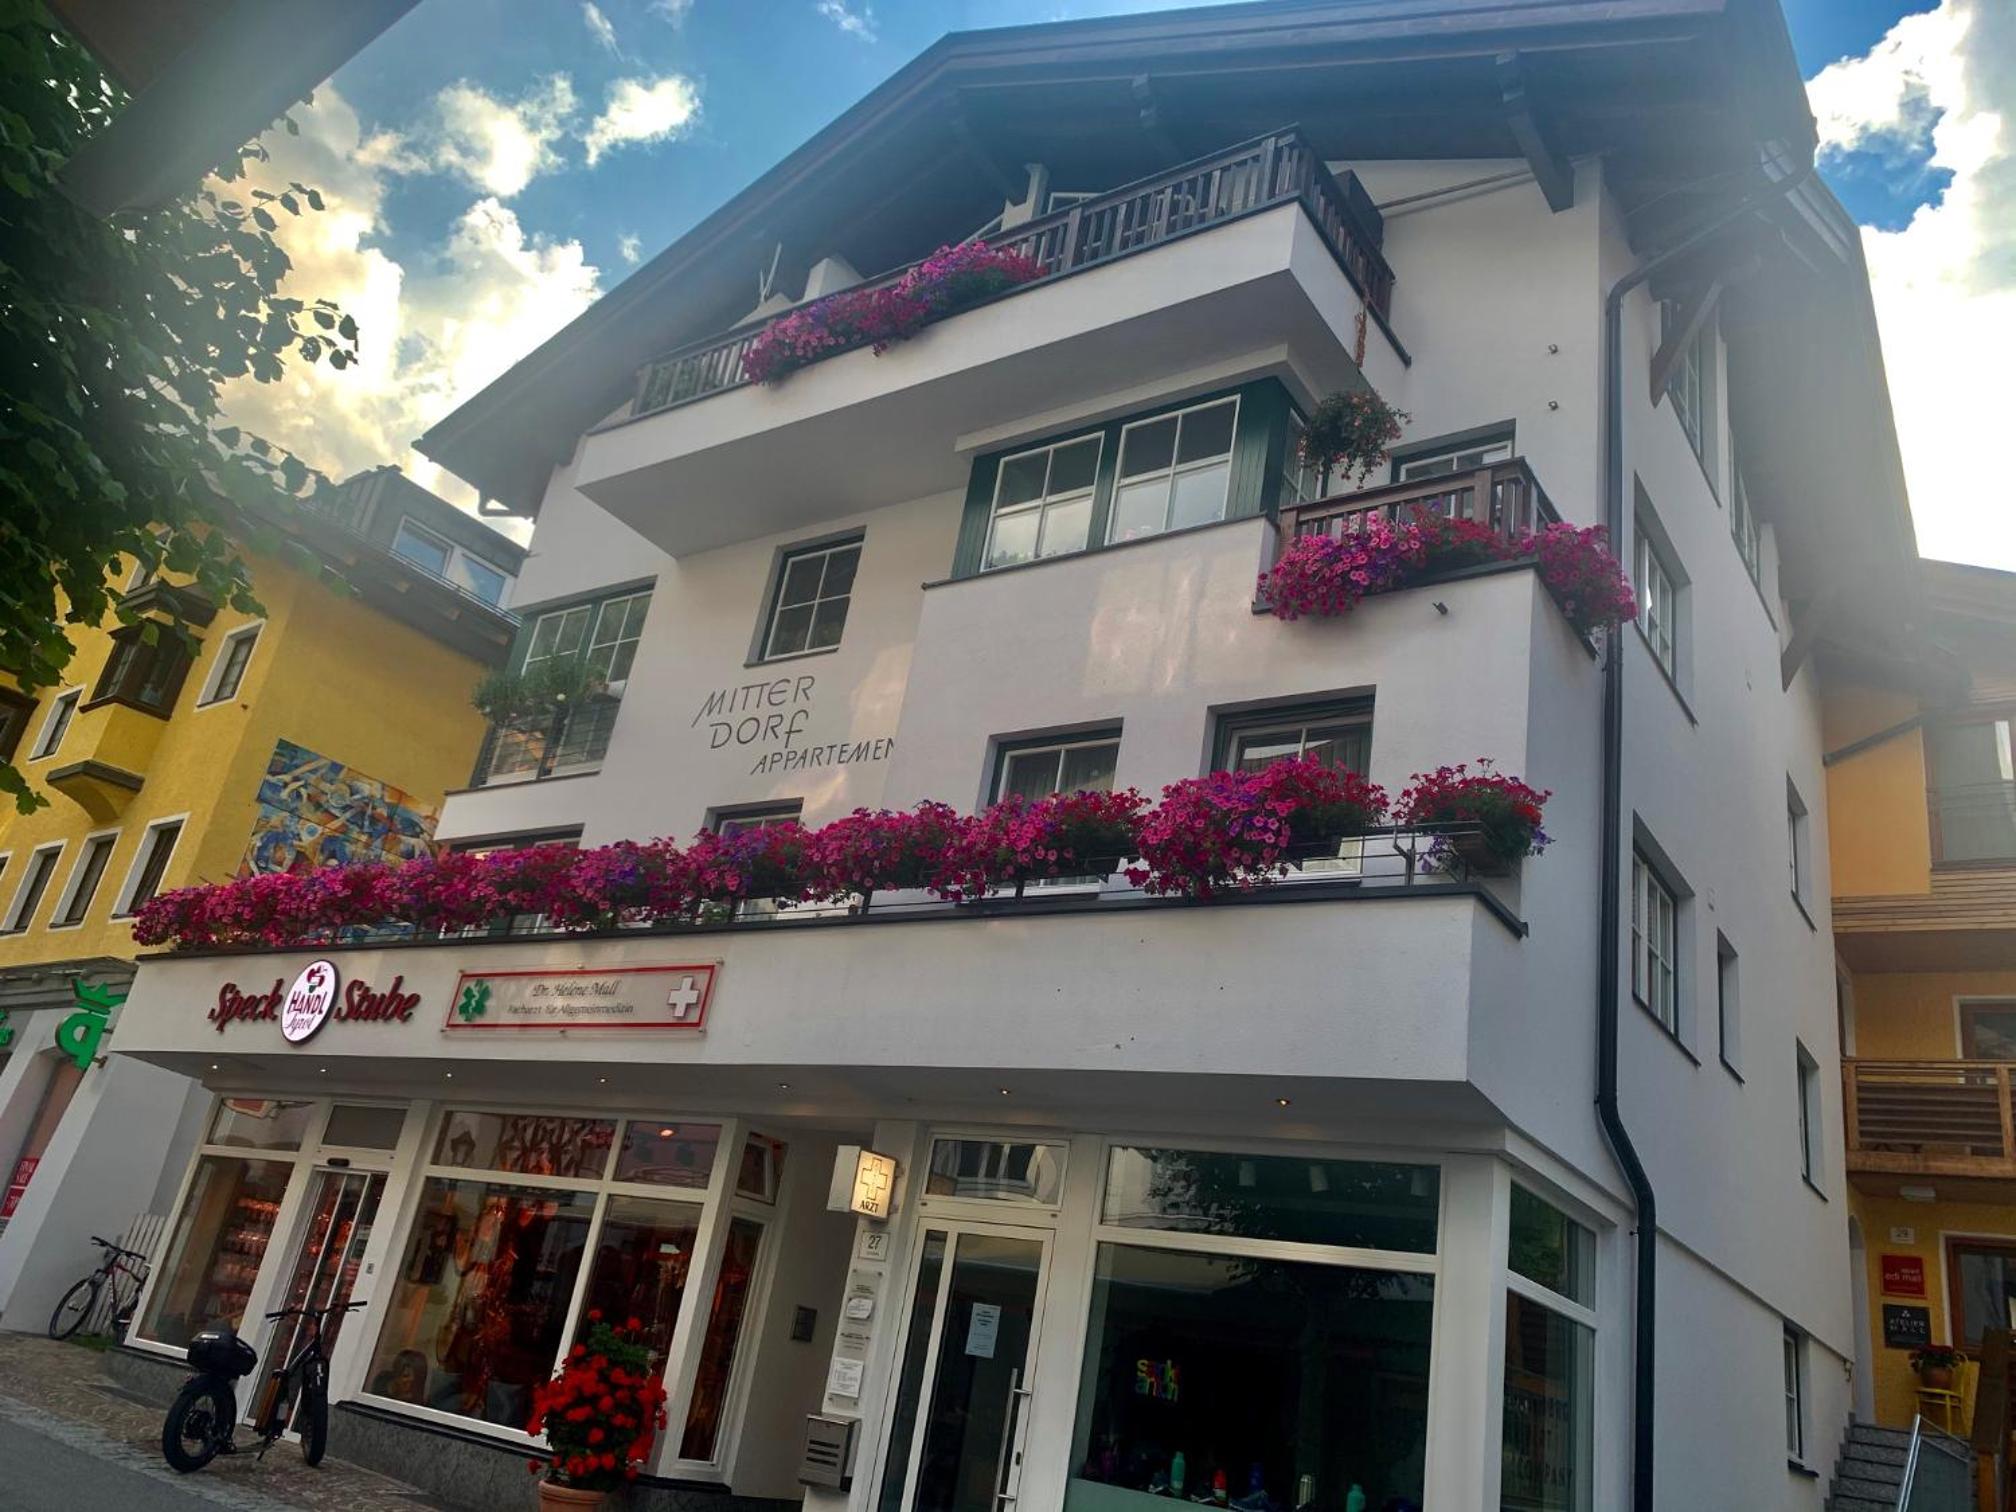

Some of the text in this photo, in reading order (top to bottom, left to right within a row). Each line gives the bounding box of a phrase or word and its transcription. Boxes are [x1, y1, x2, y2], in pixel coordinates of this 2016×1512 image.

[691, 675, 816, 728] MITTER
[208, 975, 421, 1032] Speck Stube
[287, 991, 328, 1015] HANDL
[860, 1200, 879, 1213] ARZT
[868, 1235, 881, 1250] 27
